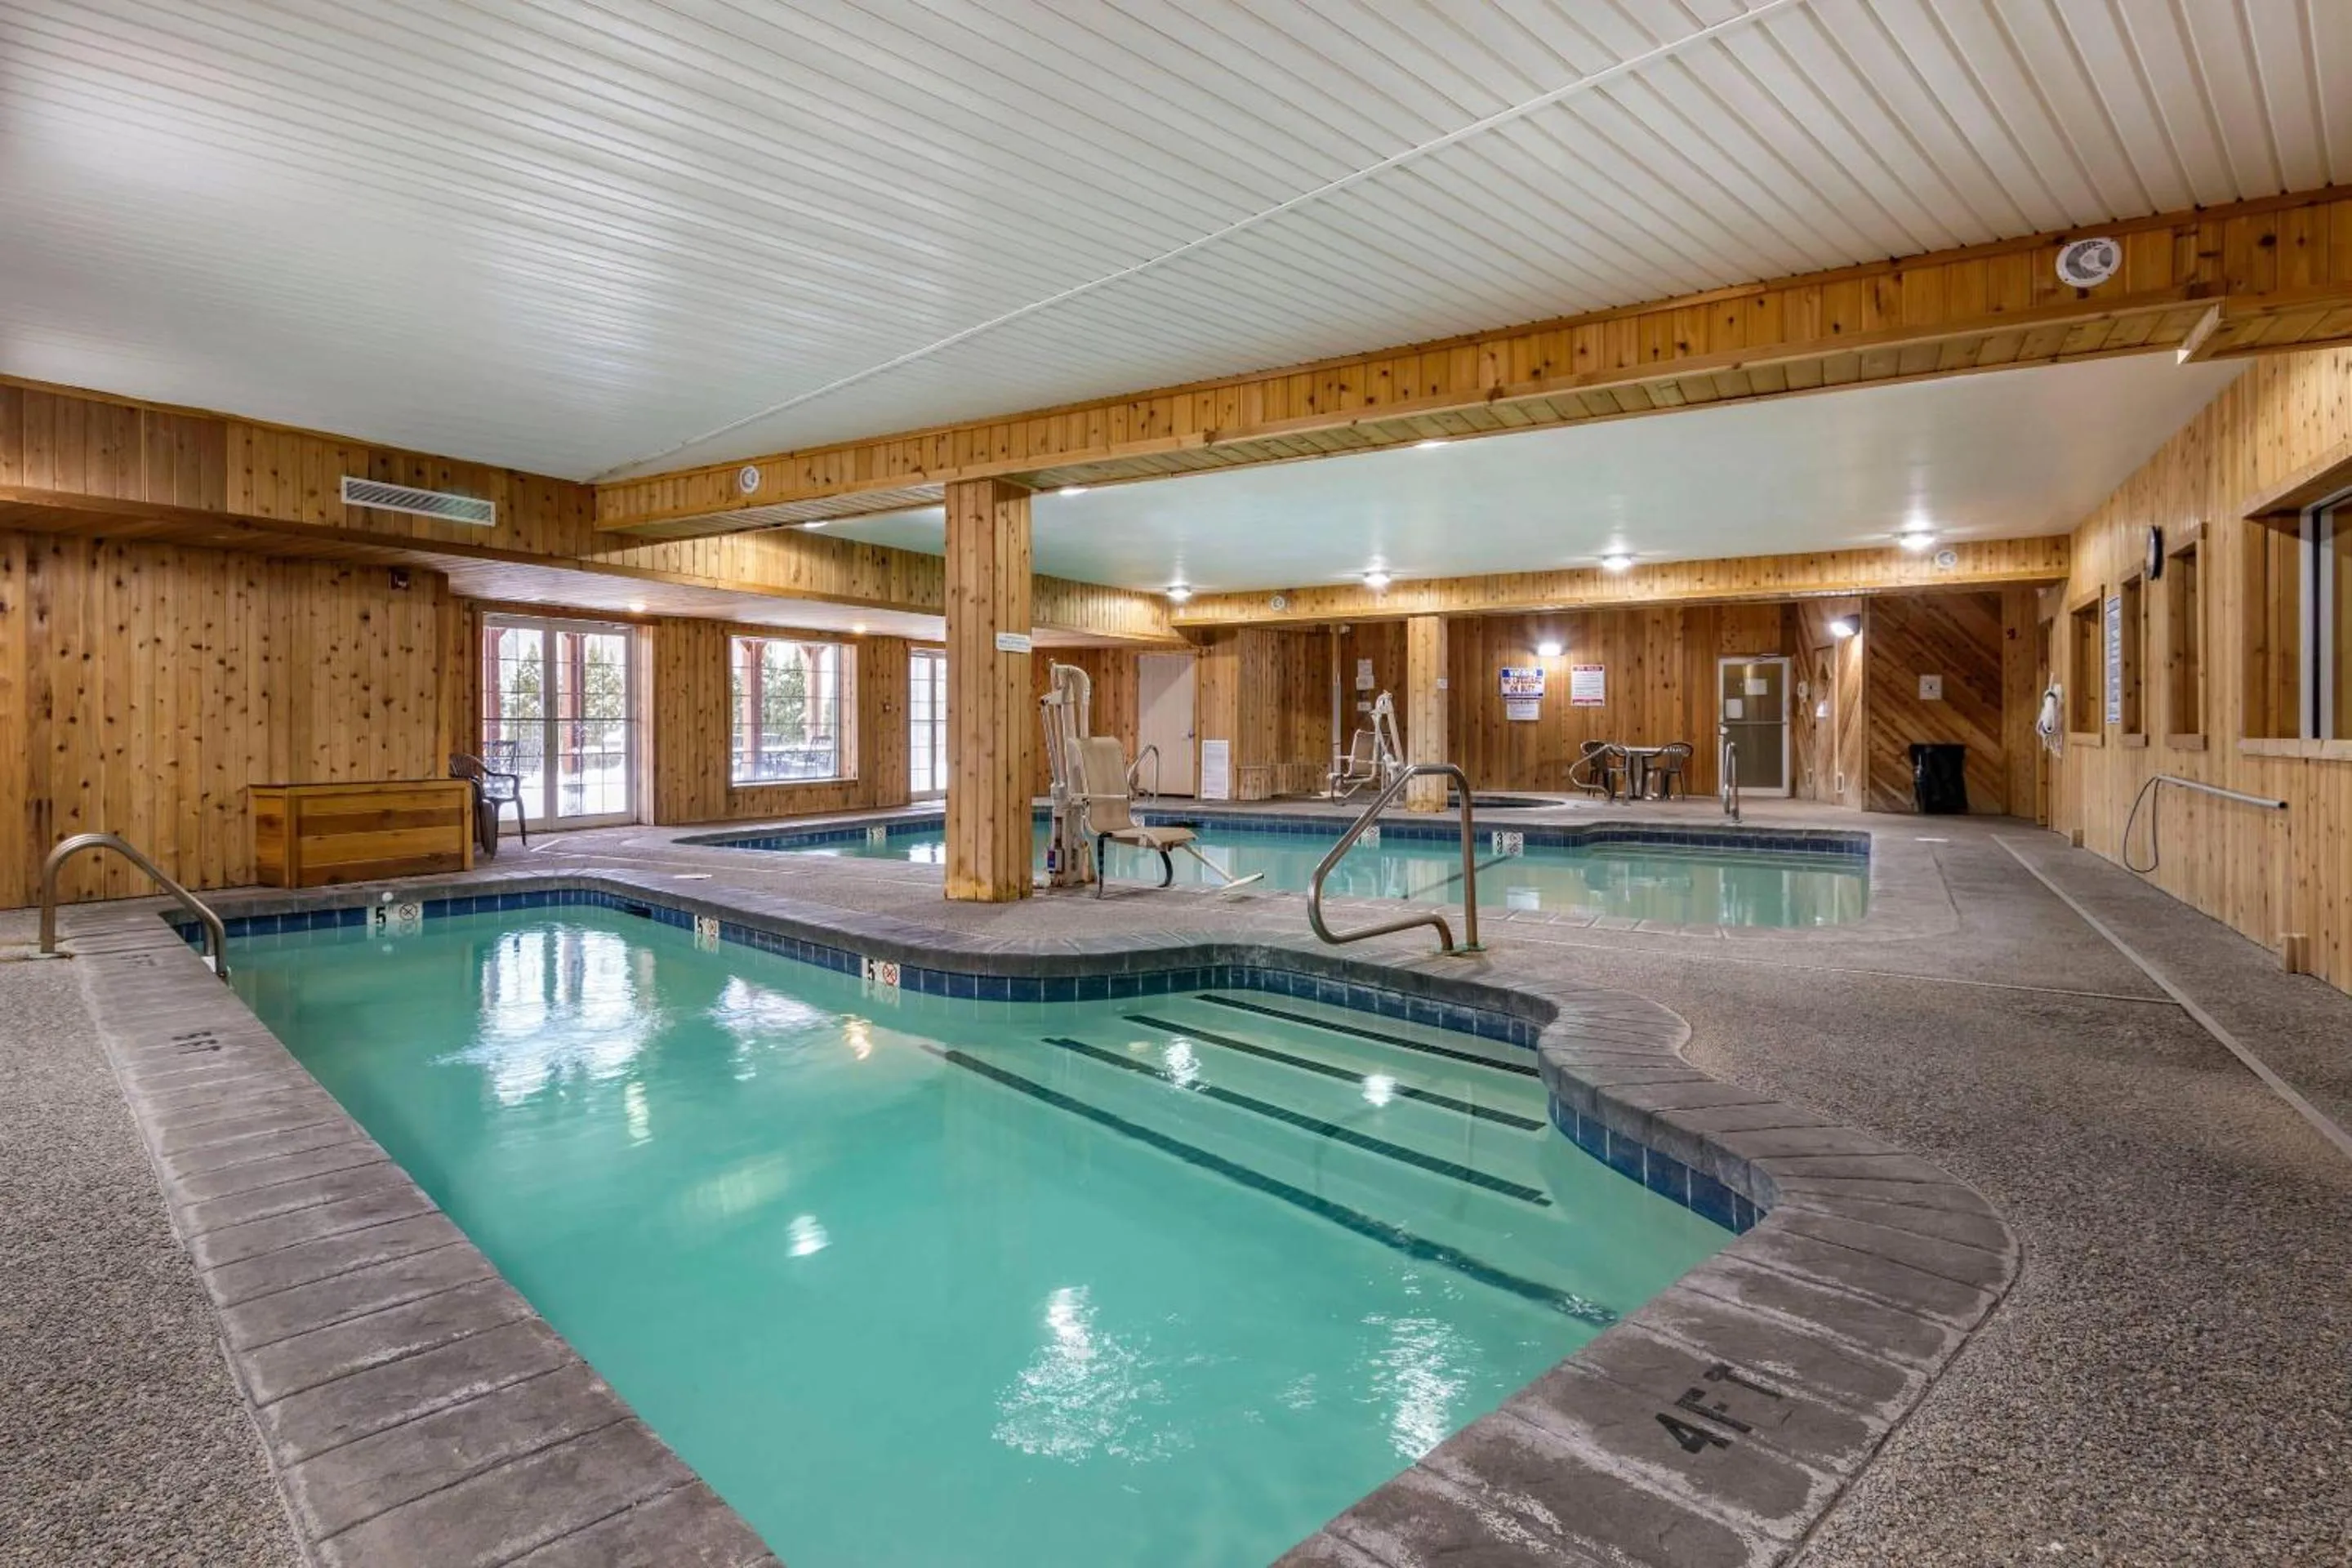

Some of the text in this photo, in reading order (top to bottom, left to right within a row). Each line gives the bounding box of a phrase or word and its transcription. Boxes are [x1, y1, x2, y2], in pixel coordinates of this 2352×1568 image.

[376, 906, 386, 924] 5
[868, 959, 875, 981] 5
[1655, 1363, 1784, 1454] 4FT
